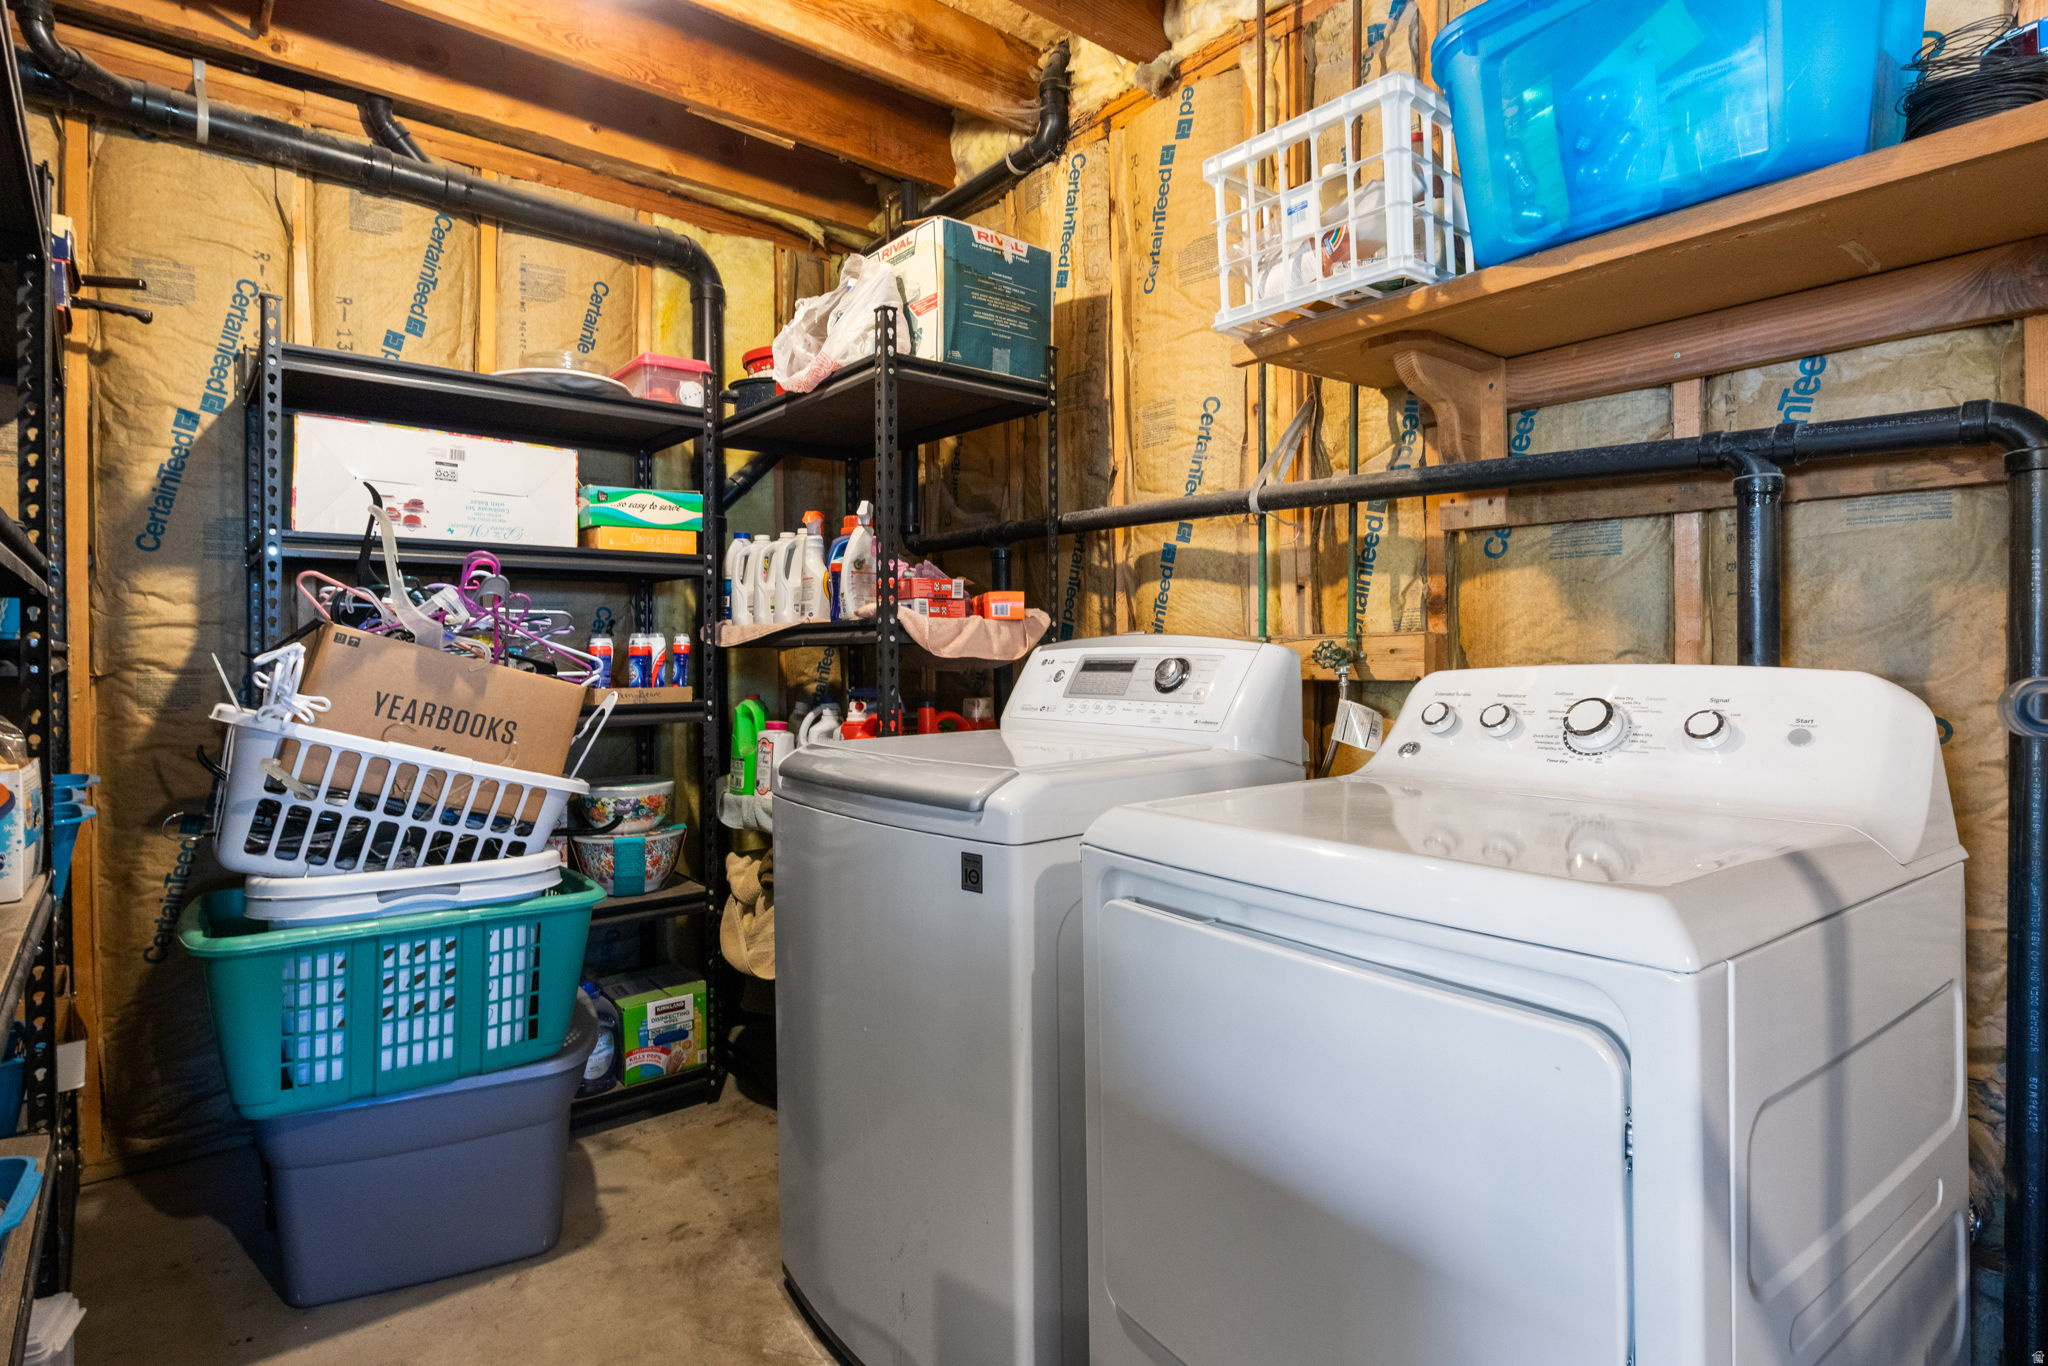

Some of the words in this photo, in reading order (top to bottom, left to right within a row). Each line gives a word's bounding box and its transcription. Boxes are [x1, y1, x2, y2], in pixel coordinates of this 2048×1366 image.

[881, 236, 913, 260] RIVAL
[977, 231, 1023, 253] RIVL
[1057, 153, 1086, 268] CertainTeed
[1143, 168, 1172, 294] CertainTeed
[410, 213, 453, 320] CertainTeed
[206, 279, 259, 395] CertainTeed
[135, 430, 194, 552] CertainTeed
[1184, 396, 1221, 497] CertainTe
[628, 503, 647, 512] easy
[649, 501, 658, 510] to
[659, 504, 681, 512] serve
[1063, 530, 1086, 623] ertainTeed
[374, 690, 518, 745] YEARBOOKS
[656, 1001, 685, 1013] KIRKLAND
